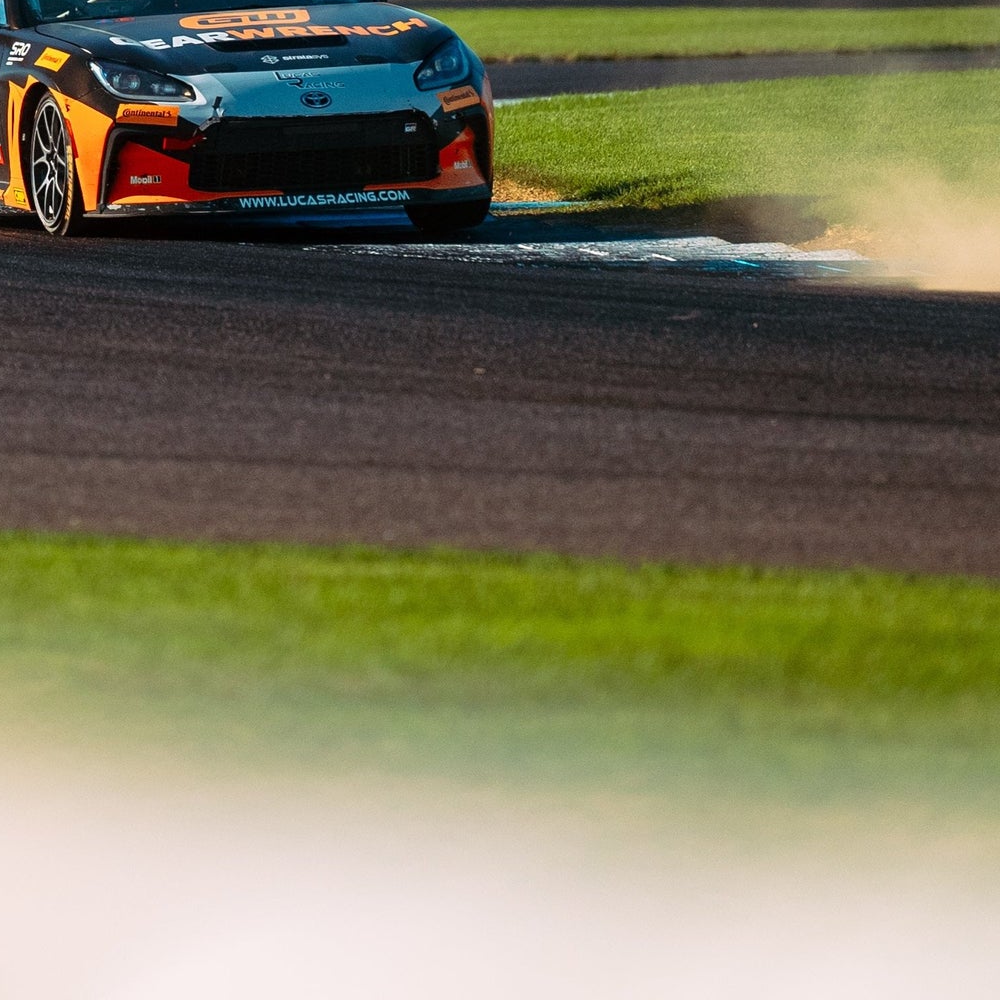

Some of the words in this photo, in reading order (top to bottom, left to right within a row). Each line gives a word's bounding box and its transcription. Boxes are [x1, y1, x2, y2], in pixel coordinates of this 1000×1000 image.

[109, 18, 429, 51] GEARWRENCH
[9, 41, 31, 57] SRO
[239, 190, 410, 208] WWW.LUCASRACING.COM
